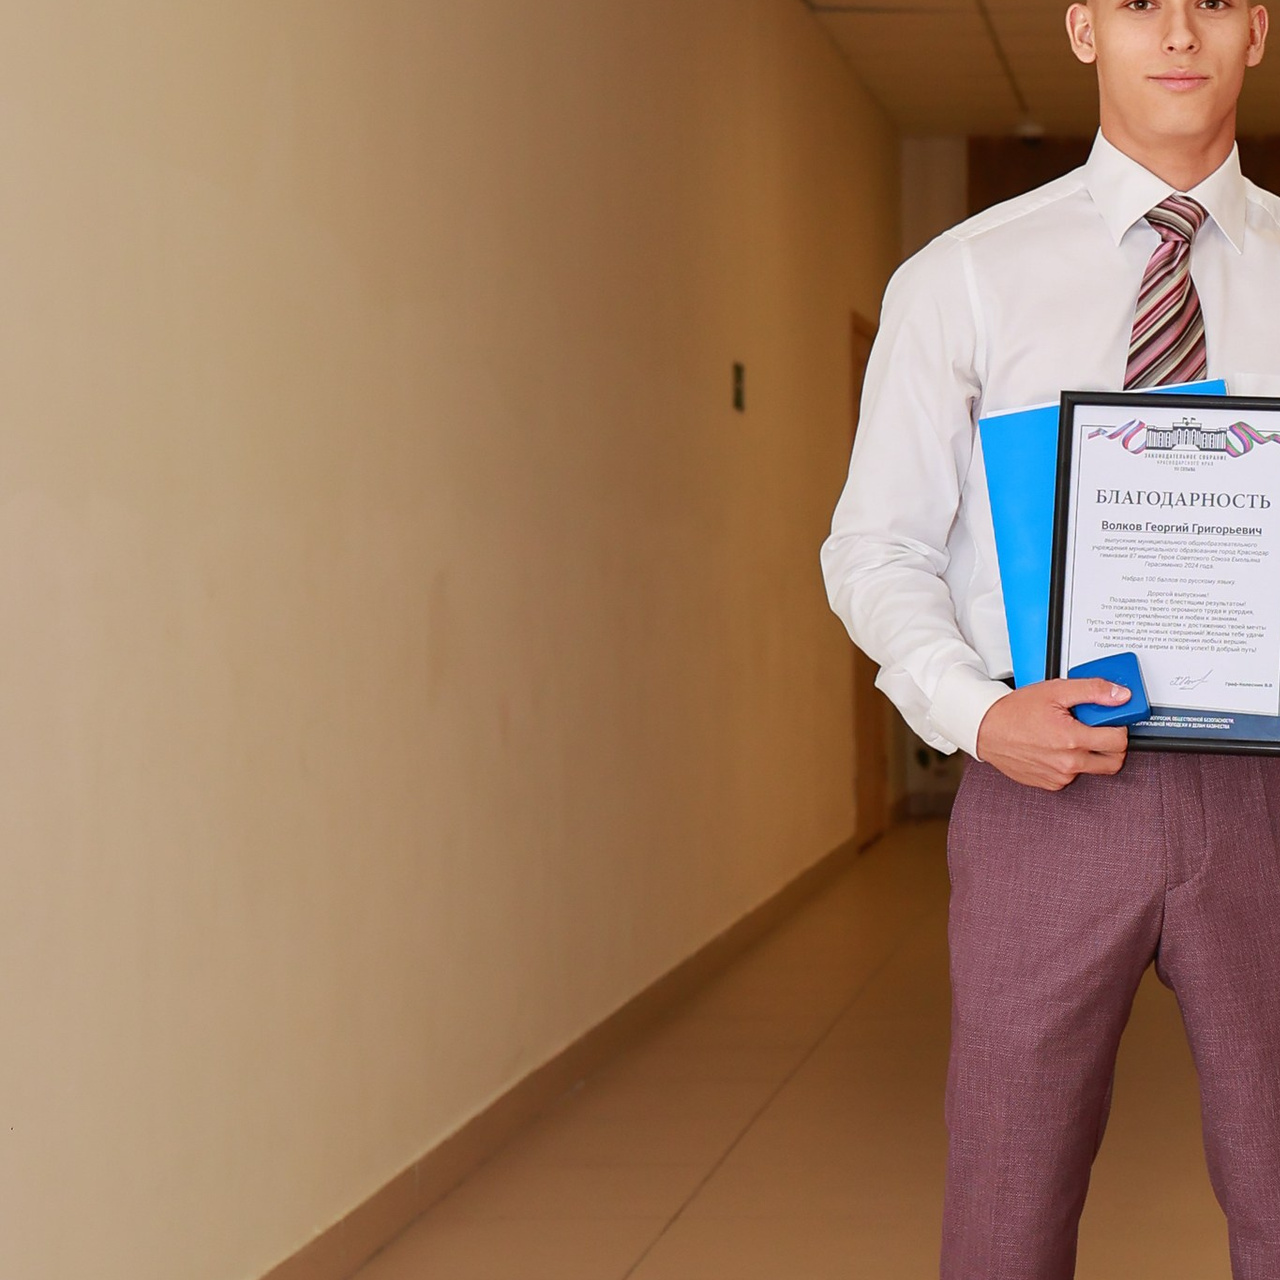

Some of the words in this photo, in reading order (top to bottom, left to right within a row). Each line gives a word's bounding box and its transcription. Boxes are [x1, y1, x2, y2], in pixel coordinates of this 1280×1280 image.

[1096, 489, 1271, 509] БЛАГОДАРНОСТЬ
[1102, 520, 1142, 531] Волков
[1145, 522, 1189, 535] Георгий
[1192, 524, 1262, 535] Григорьевич
